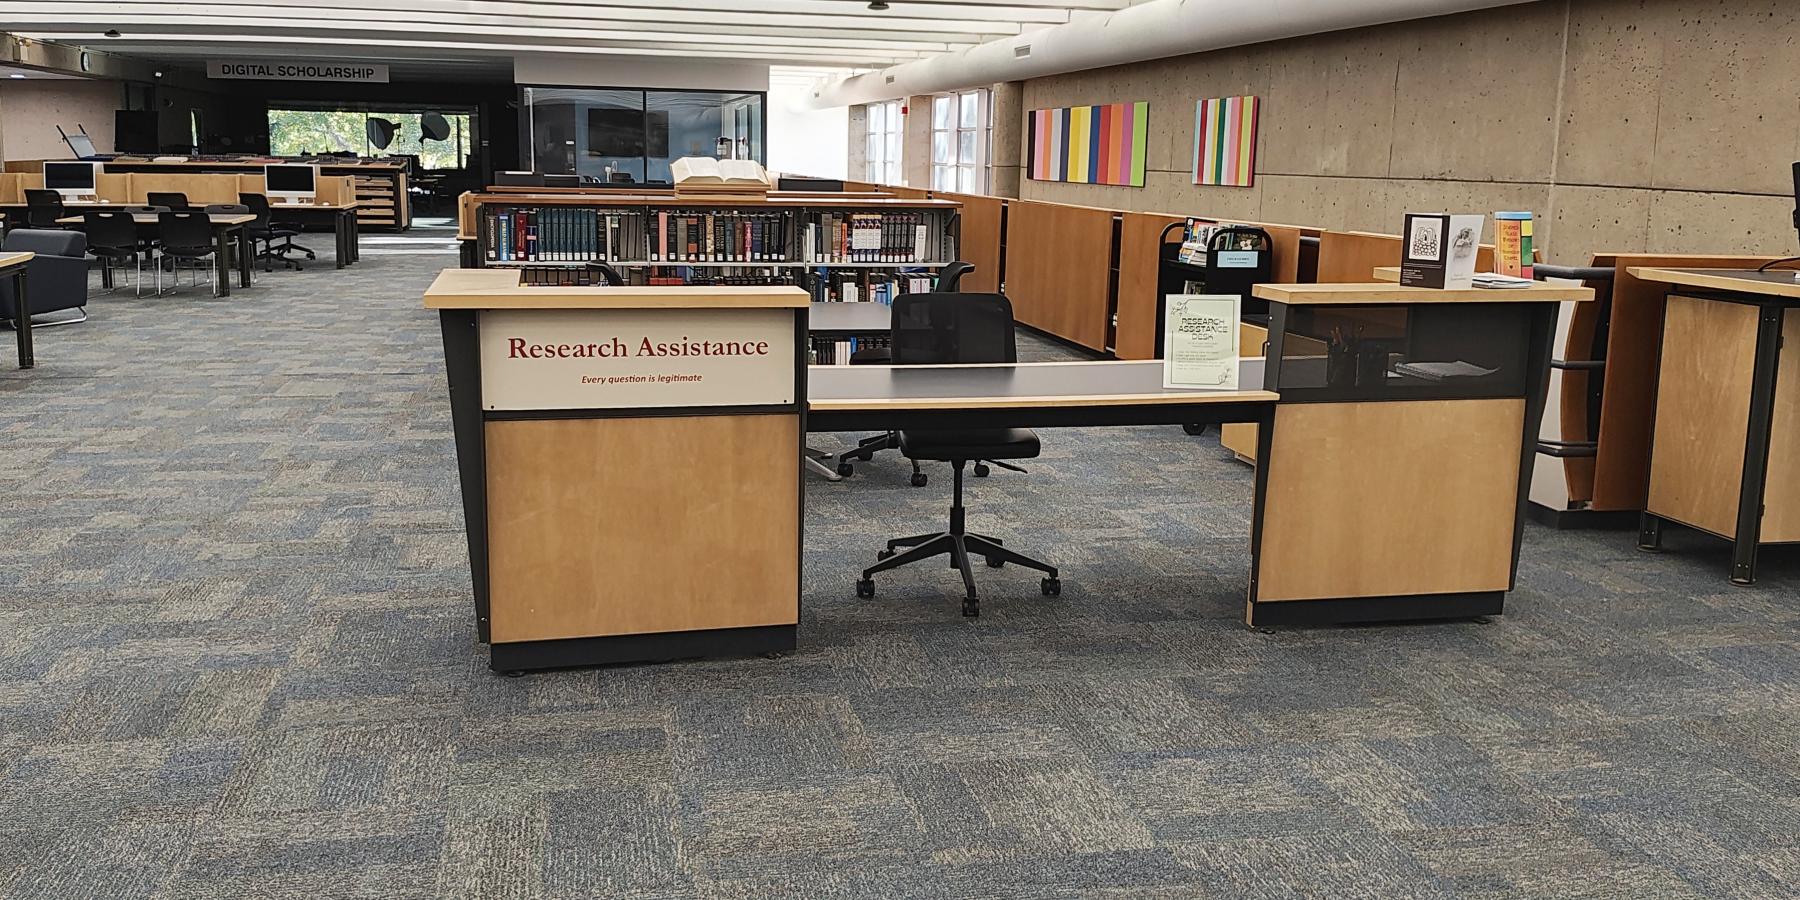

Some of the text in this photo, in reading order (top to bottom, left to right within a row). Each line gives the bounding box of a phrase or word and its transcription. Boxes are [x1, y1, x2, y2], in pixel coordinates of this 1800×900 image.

[221, 64, 374, 79] DIGITAL SCHOLARSHIP
[507, 336, 769, 359] Research Assistance
[581, 373, 703, 384] Every question is legitimate
